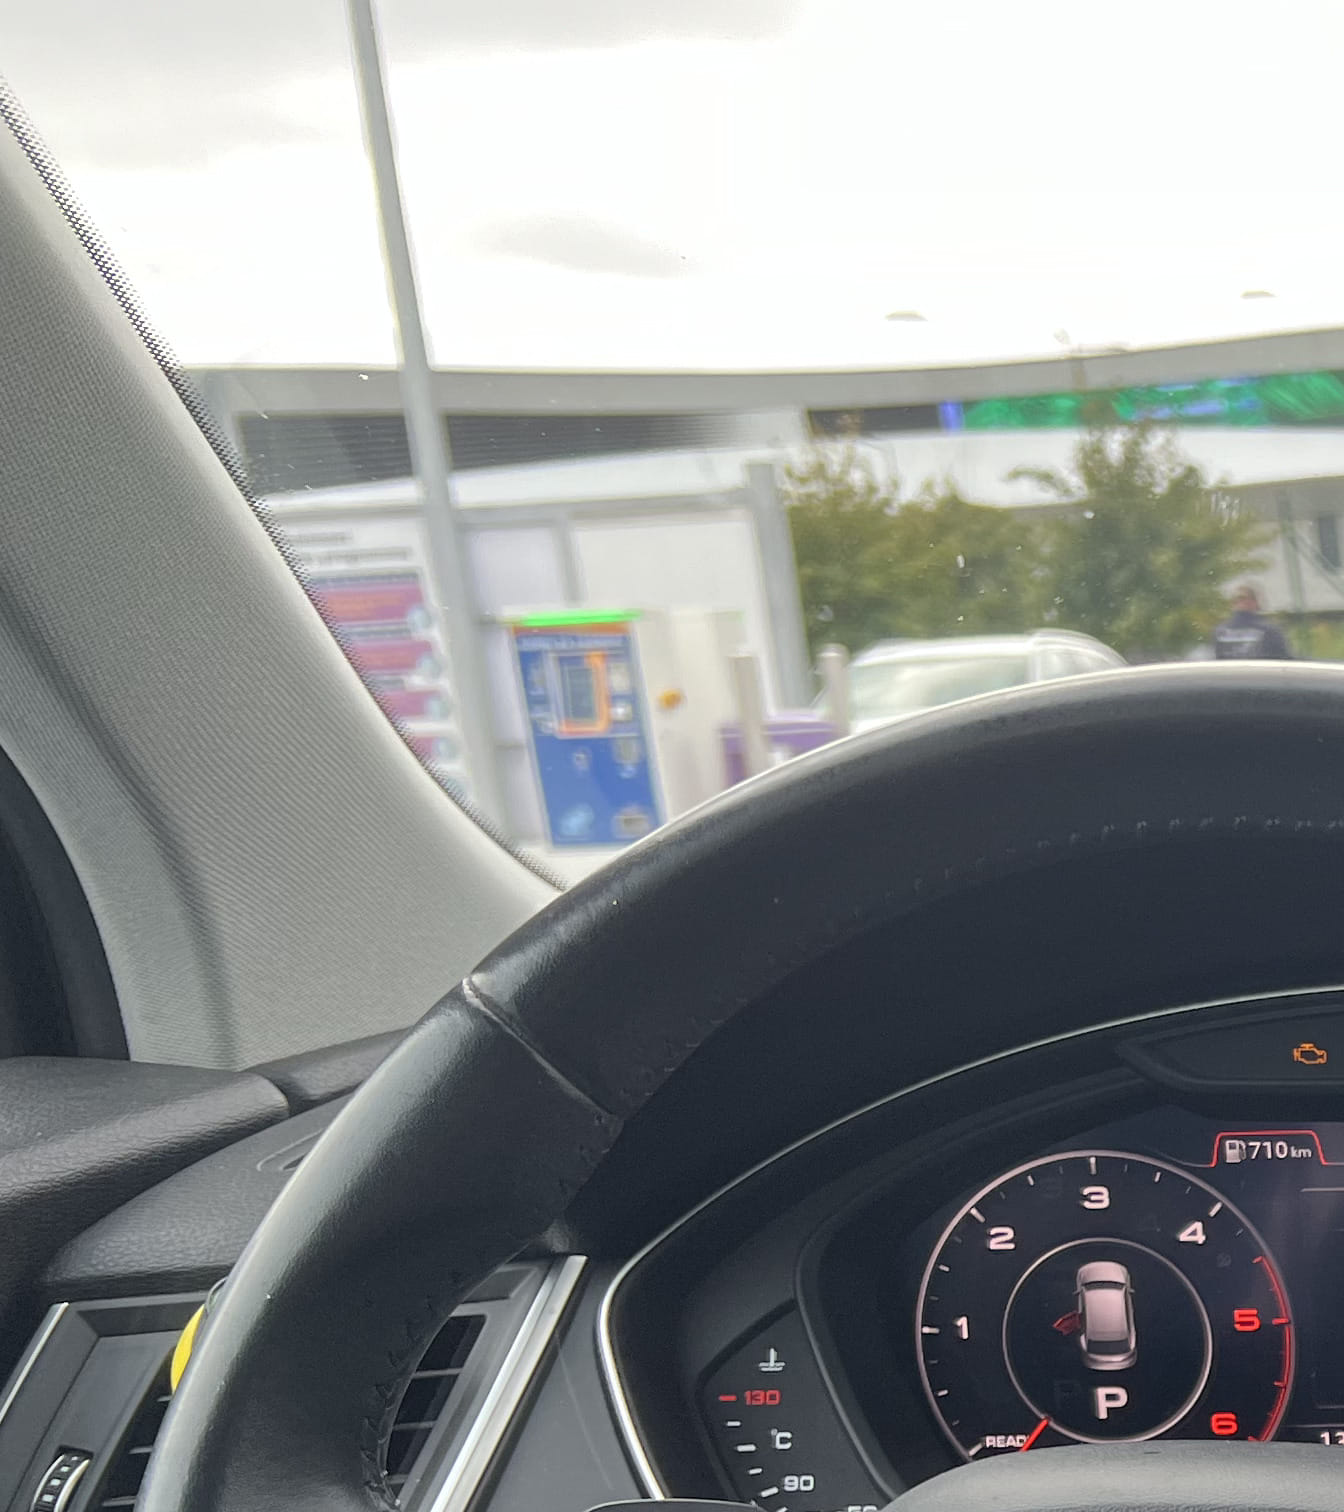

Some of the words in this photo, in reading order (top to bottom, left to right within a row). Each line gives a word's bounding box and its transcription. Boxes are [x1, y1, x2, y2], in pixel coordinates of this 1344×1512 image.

[1082, 1186, 1110, 1210] 3
[988, 1227, 1015, 1251] 2
[1178, 1221, 1205, 1244] 4
[955, 1317, 971, 1338] 1
[1234, 1310, 1260, 1332] 5
[745, 1390, 780, 1405] 130
[1096, 1387, 1128, 1419] P
[1211, 1414, 1238, 1435] 6
[986, 1434, 1030, 1448] READ
[783, 1475, 814, 1491] 90
